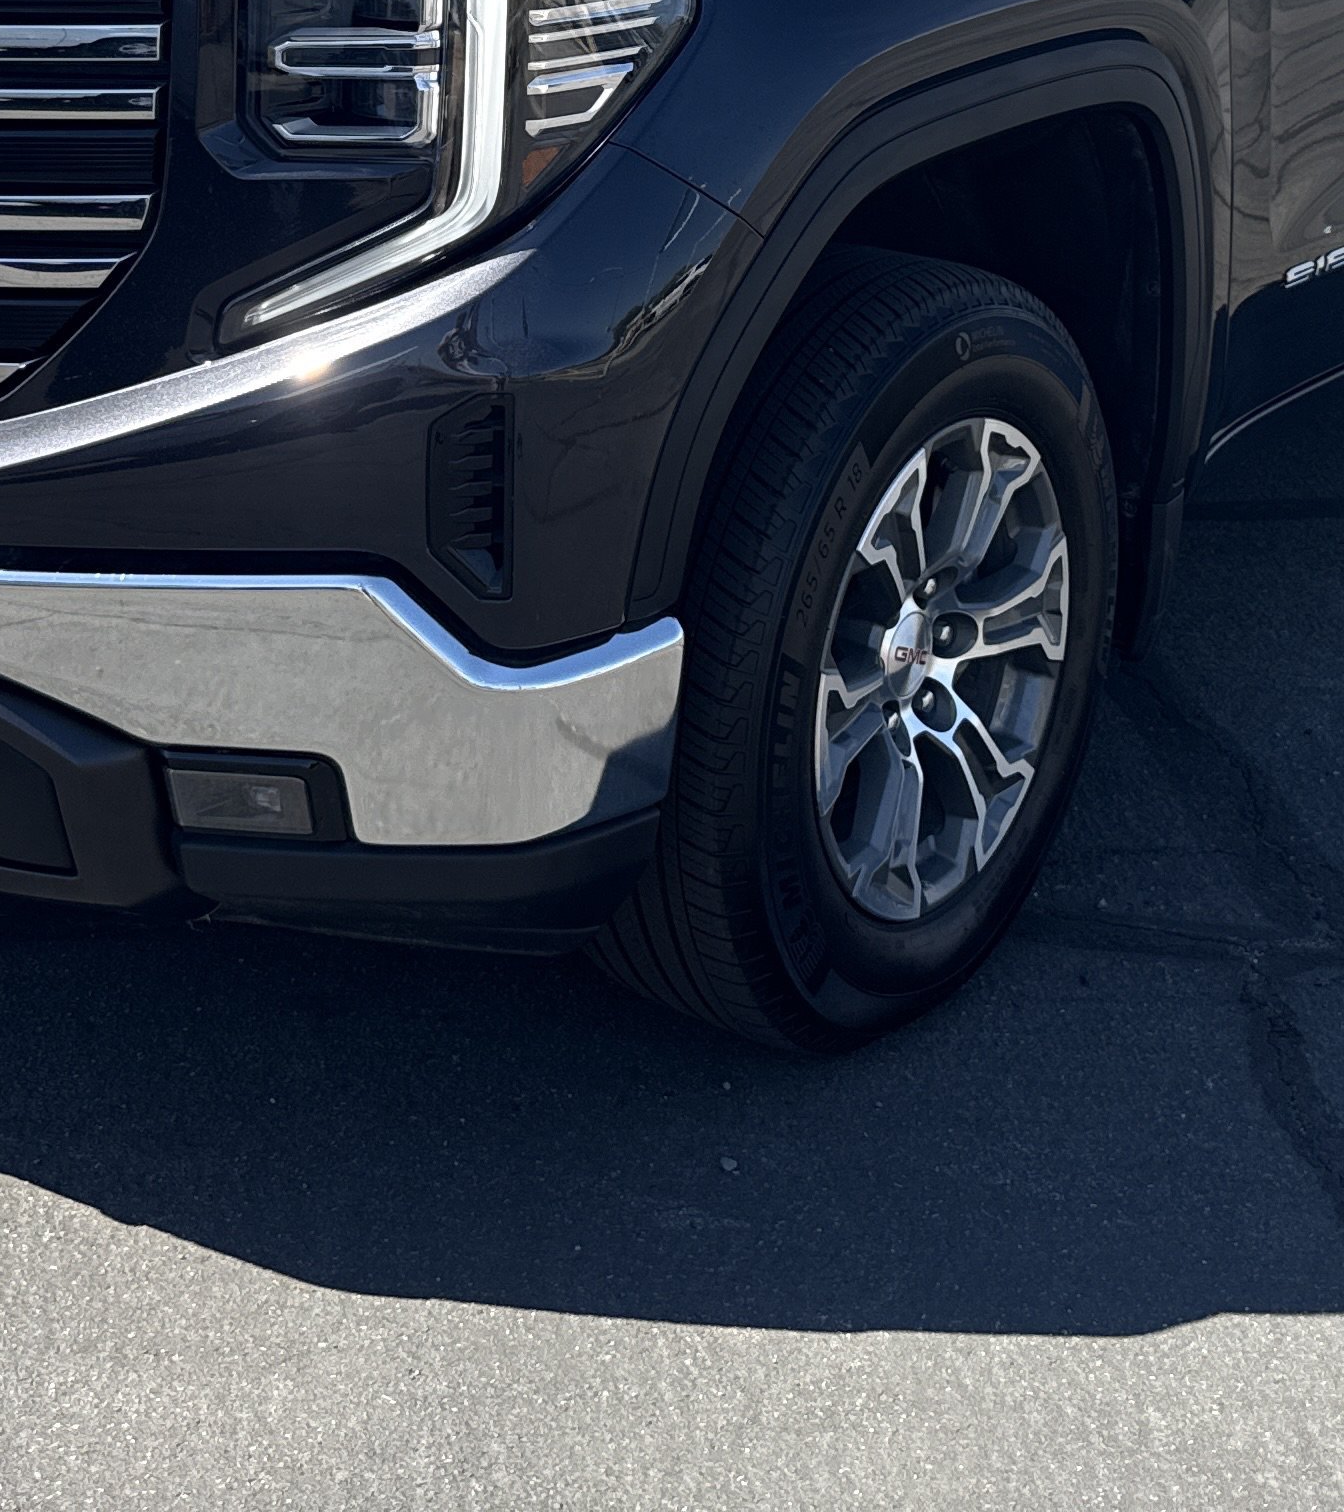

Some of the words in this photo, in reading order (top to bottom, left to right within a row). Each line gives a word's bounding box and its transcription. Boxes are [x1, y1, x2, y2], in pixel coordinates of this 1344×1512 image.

[796, 521, 835, 628] 265/65
[834, 496, 847, 520] R
[847, 462, 862, 492] 18
[895, 646, 928, 665] GMC
